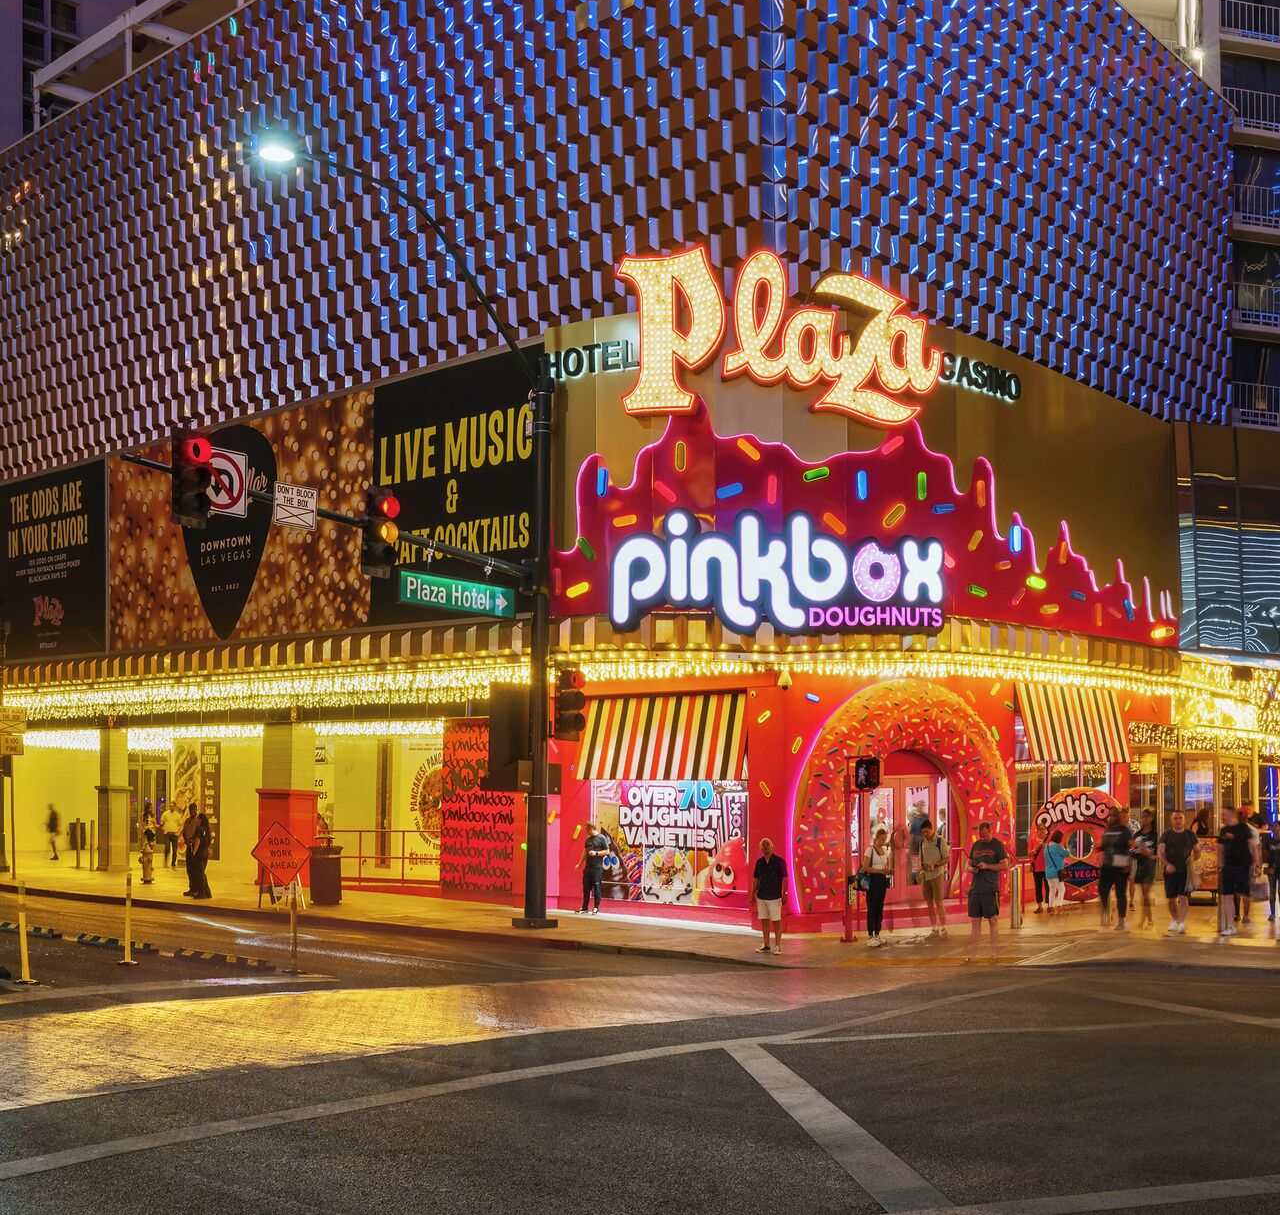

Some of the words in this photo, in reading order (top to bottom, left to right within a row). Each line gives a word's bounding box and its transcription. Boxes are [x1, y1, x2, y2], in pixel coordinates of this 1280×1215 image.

[616, 247, 942, 424] Plaza
[545, 339, 640, 380] HOTEL
[938, 351, 1021, 402] CASINO
[379, 426, 437, 486] LIVE
[444, 403, 533, 475] MUSIC
[10, 494, 29, 524] THE
[32, 486, 59, 519] ODDS
[62, 480, 82, 513] ARE
[277, 485, 294, 497] DON'T
[296, 488, 315, 500] BLOCK
[283, 496, 294, 506] THE
[297, 499, 309, 509] BOX
[446, 478, 458, 514] &
[8, 529, 18, 558] IN
[21, 523, 48, 555] YOUR
[51, 514, 88, 550] FAVOR!
[201, 535, 251, 553] DOWNTOWN
[394, 529, 430, 566] AFT
[434, 512, 530, 562] COCKTAILS
[201, 555, 216, 566] LAS
[221, 550, 251, 563] VEGAS
[613, 512, 943, 628] pinkbox
[406, 577, 447, 604] Plaza
[451, 584, 490, 611] Hotel
[33, 596, 64, 626] Plaza
[808, 607, 943, 628] DOUGHNUTS
[627, 786, 676, 807] OVER
[678, 779, 715, 810] 70
[619, 806, 722, 829] DOUGHNUT
[1036, 794, 1110, 833] pinkbo
[268, 838, 290, 847] ROAD
[270, 850, 293, 858] WORK
[623, 828, 716, 850] VARIETIES
[270, 862, 297, 870] AHEAD
